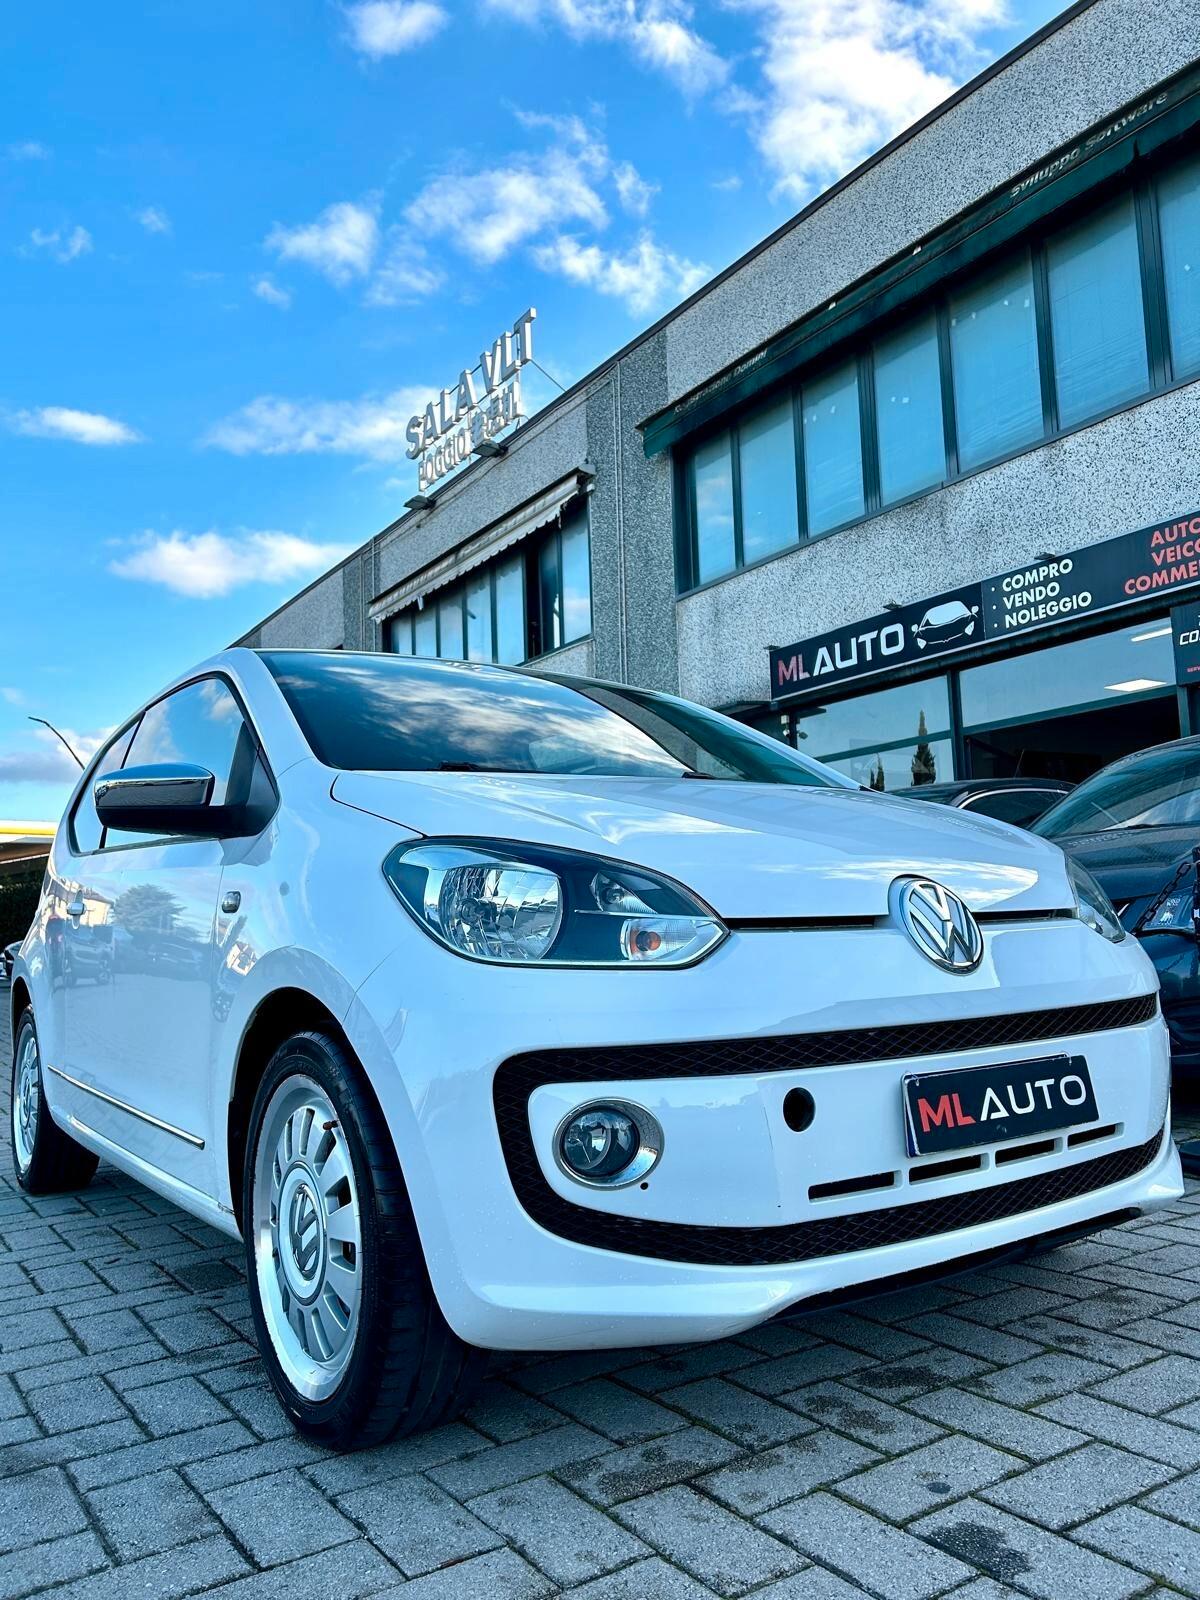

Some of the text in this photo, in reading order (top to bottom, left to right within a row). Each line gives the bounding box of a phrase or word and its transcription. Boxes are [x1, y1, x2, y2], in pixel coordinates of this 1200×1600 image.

[406, 369, 478, 459] SALA
[480, 307, 536, 393] VLT
[1002, 559, 1073, 592] COMPRO
[1124, 560, 1200, 594] COMME
[1003, 581, 1060, 610] VENDO
[1005, 591, 1092, 629] NOLEGGIO
[1180, 629, 1200, 645] CO
